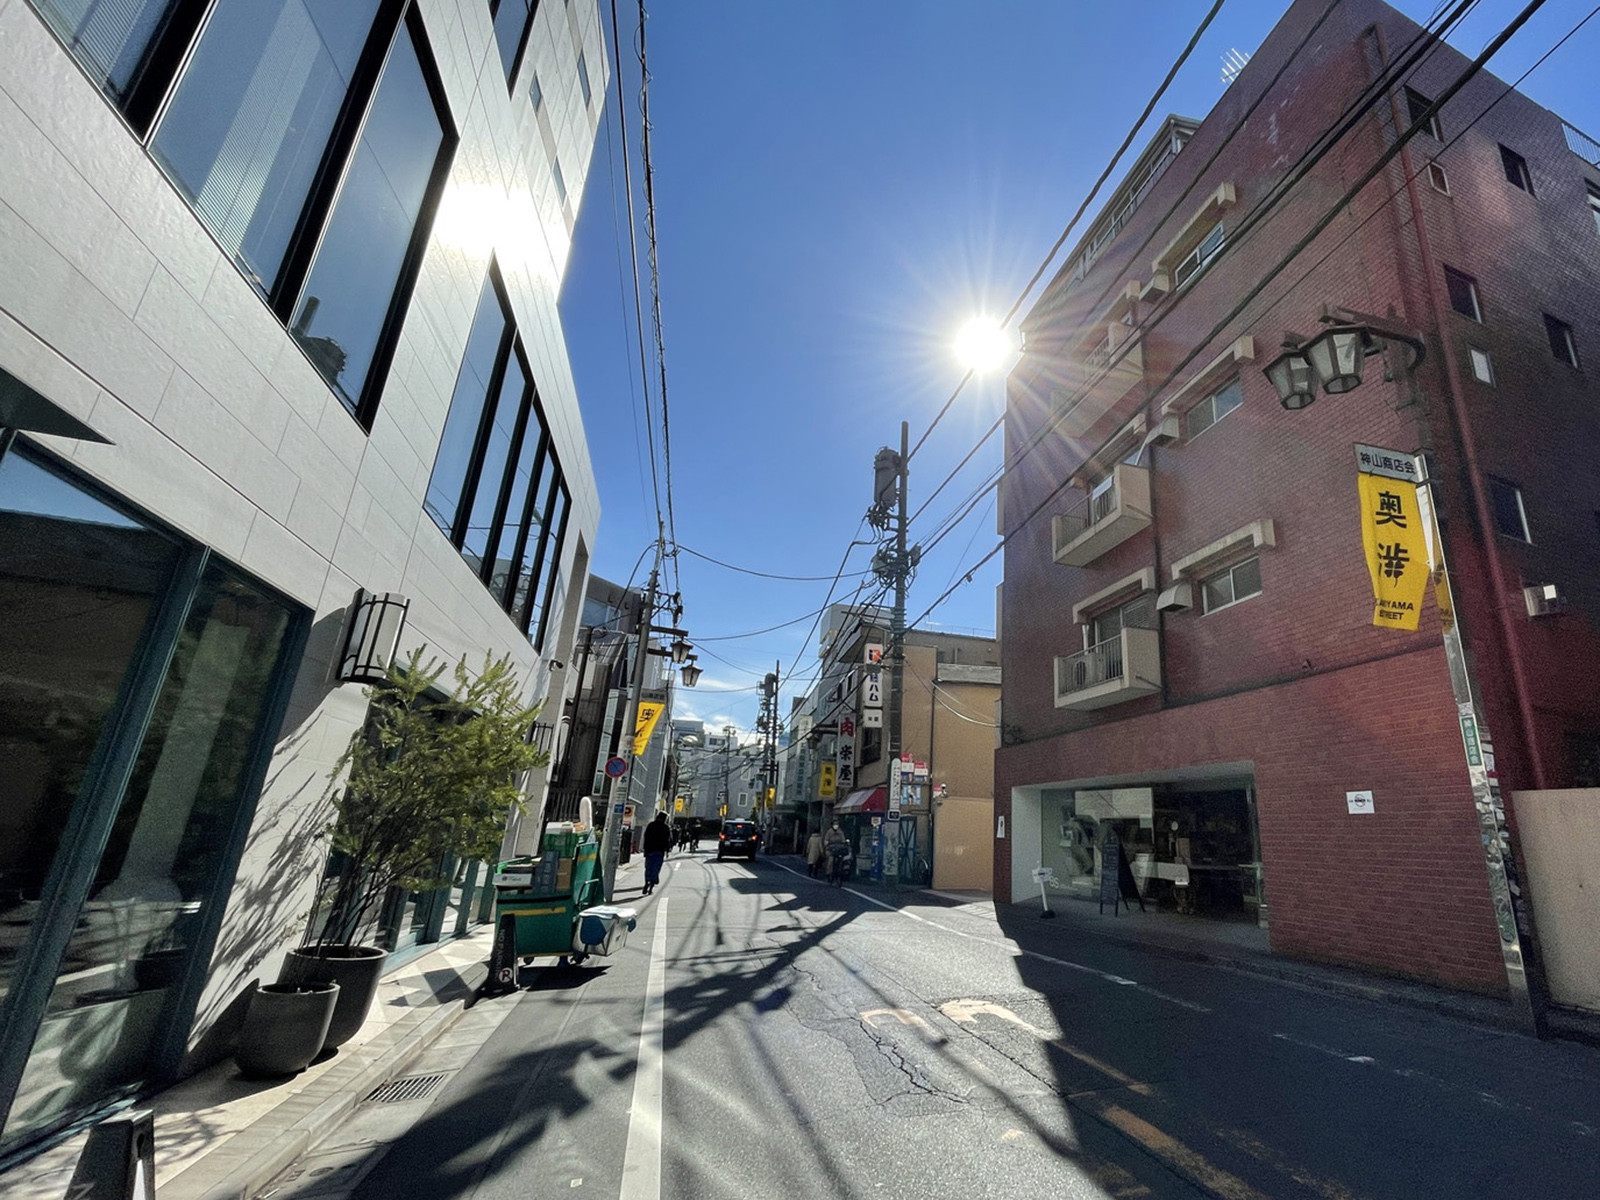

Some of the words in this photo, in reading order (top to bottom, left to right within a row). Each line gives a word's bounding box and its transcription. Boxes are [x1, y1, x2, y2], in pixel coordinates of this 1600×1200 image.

[1360, 451, 1416, 474] 神山商店会
